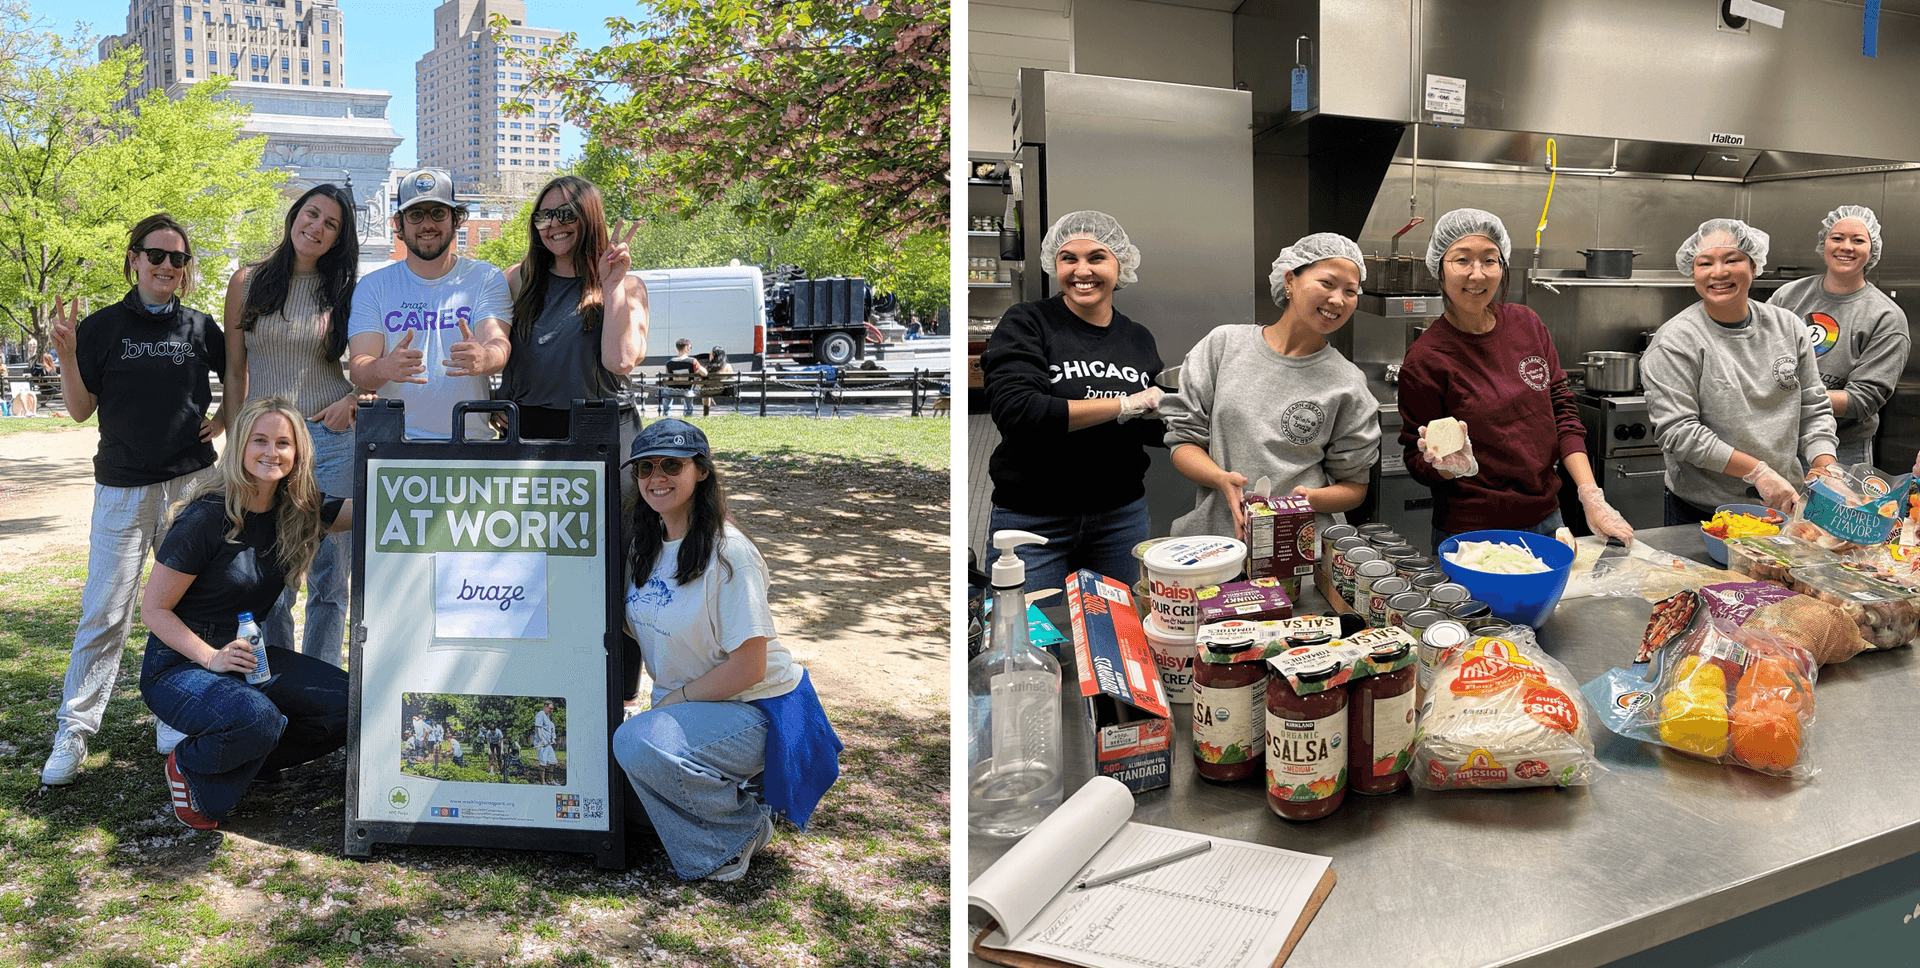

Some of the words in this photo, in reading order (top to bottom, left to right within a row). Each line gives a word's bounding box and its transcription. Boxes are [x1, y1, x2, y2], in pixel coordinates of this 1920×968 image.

[1711, 133, 1743, 145] Halton
[401, 301, 428, 314] braze
[384, 306, 472, 333] CARES
[121, 338, 195, 365] braze
[1049, 360, 1150, 389] CHICAGO
[381, 475, 590, 506] VOLUNTEERS
[1832, 503, 1881, 528] INSPIRED
[379, 508, 434, 546] AT
[446, 510, 590, 549] WORK!
[1830, 515, 1873, 538] FLAVOR
[1885, 528, 1903, 544] SUNSE
[456, 579, 526, 611] braze
[1155, 580, 1195, 603] Daisy
[1152, 600, 1171, 615] OUR
[1283, 618, 1334, 628] SALSA
[1348, 626, 1400, 645] SALSA
[1150, 645, 1188, 672] aisy
[1162, 673, 1194, 685] CREA
[1535, 695, 1569, 708] super
[1531, 703, 1573, 724] soft
[1281, 730, 1319, 739] ORGANIC
[1273, 735, 1329, 762] SALSA
[1113, 763, 1166, 782] STANDARD
[1286, 765, 1311, 773] MEDIUM
